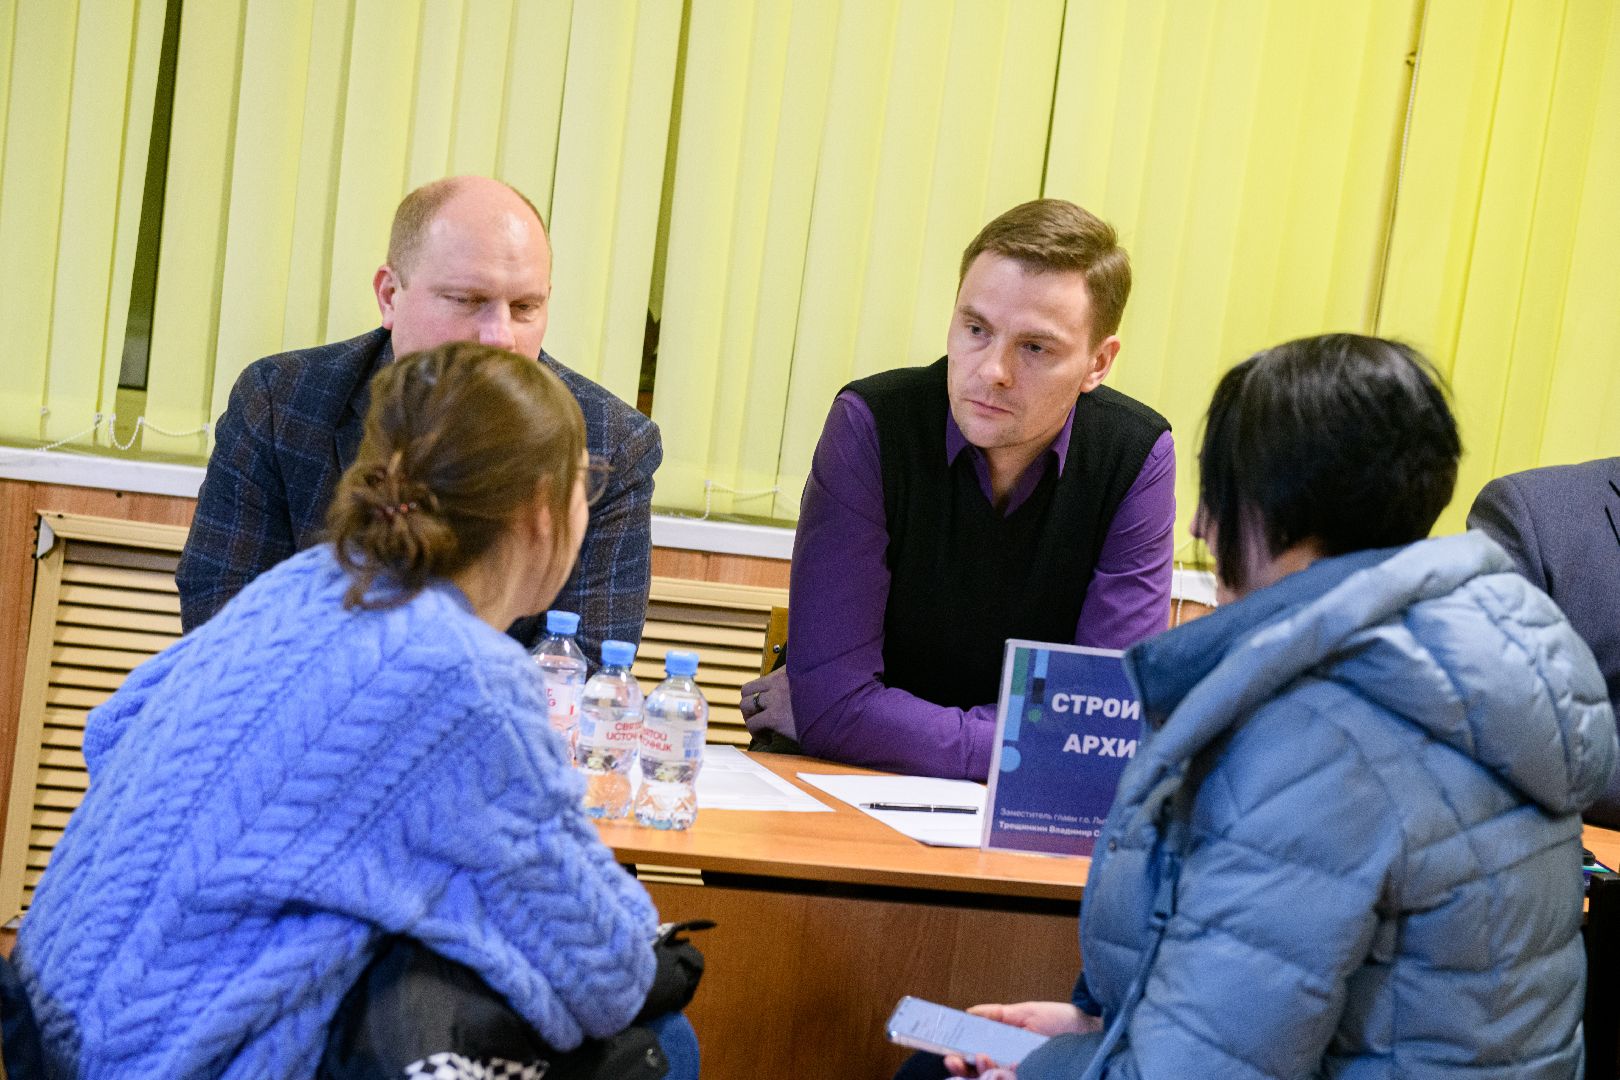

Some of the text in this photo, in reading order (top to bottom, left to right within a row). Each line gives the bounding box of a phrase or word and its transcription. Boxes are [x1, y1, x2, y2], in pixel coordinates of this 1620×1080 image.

[1052, 692, 1140, 720] СТРОИ
[1062, 733, 1141, 759] АРХИ
[1049, 825, 1092, 838] Владимир
